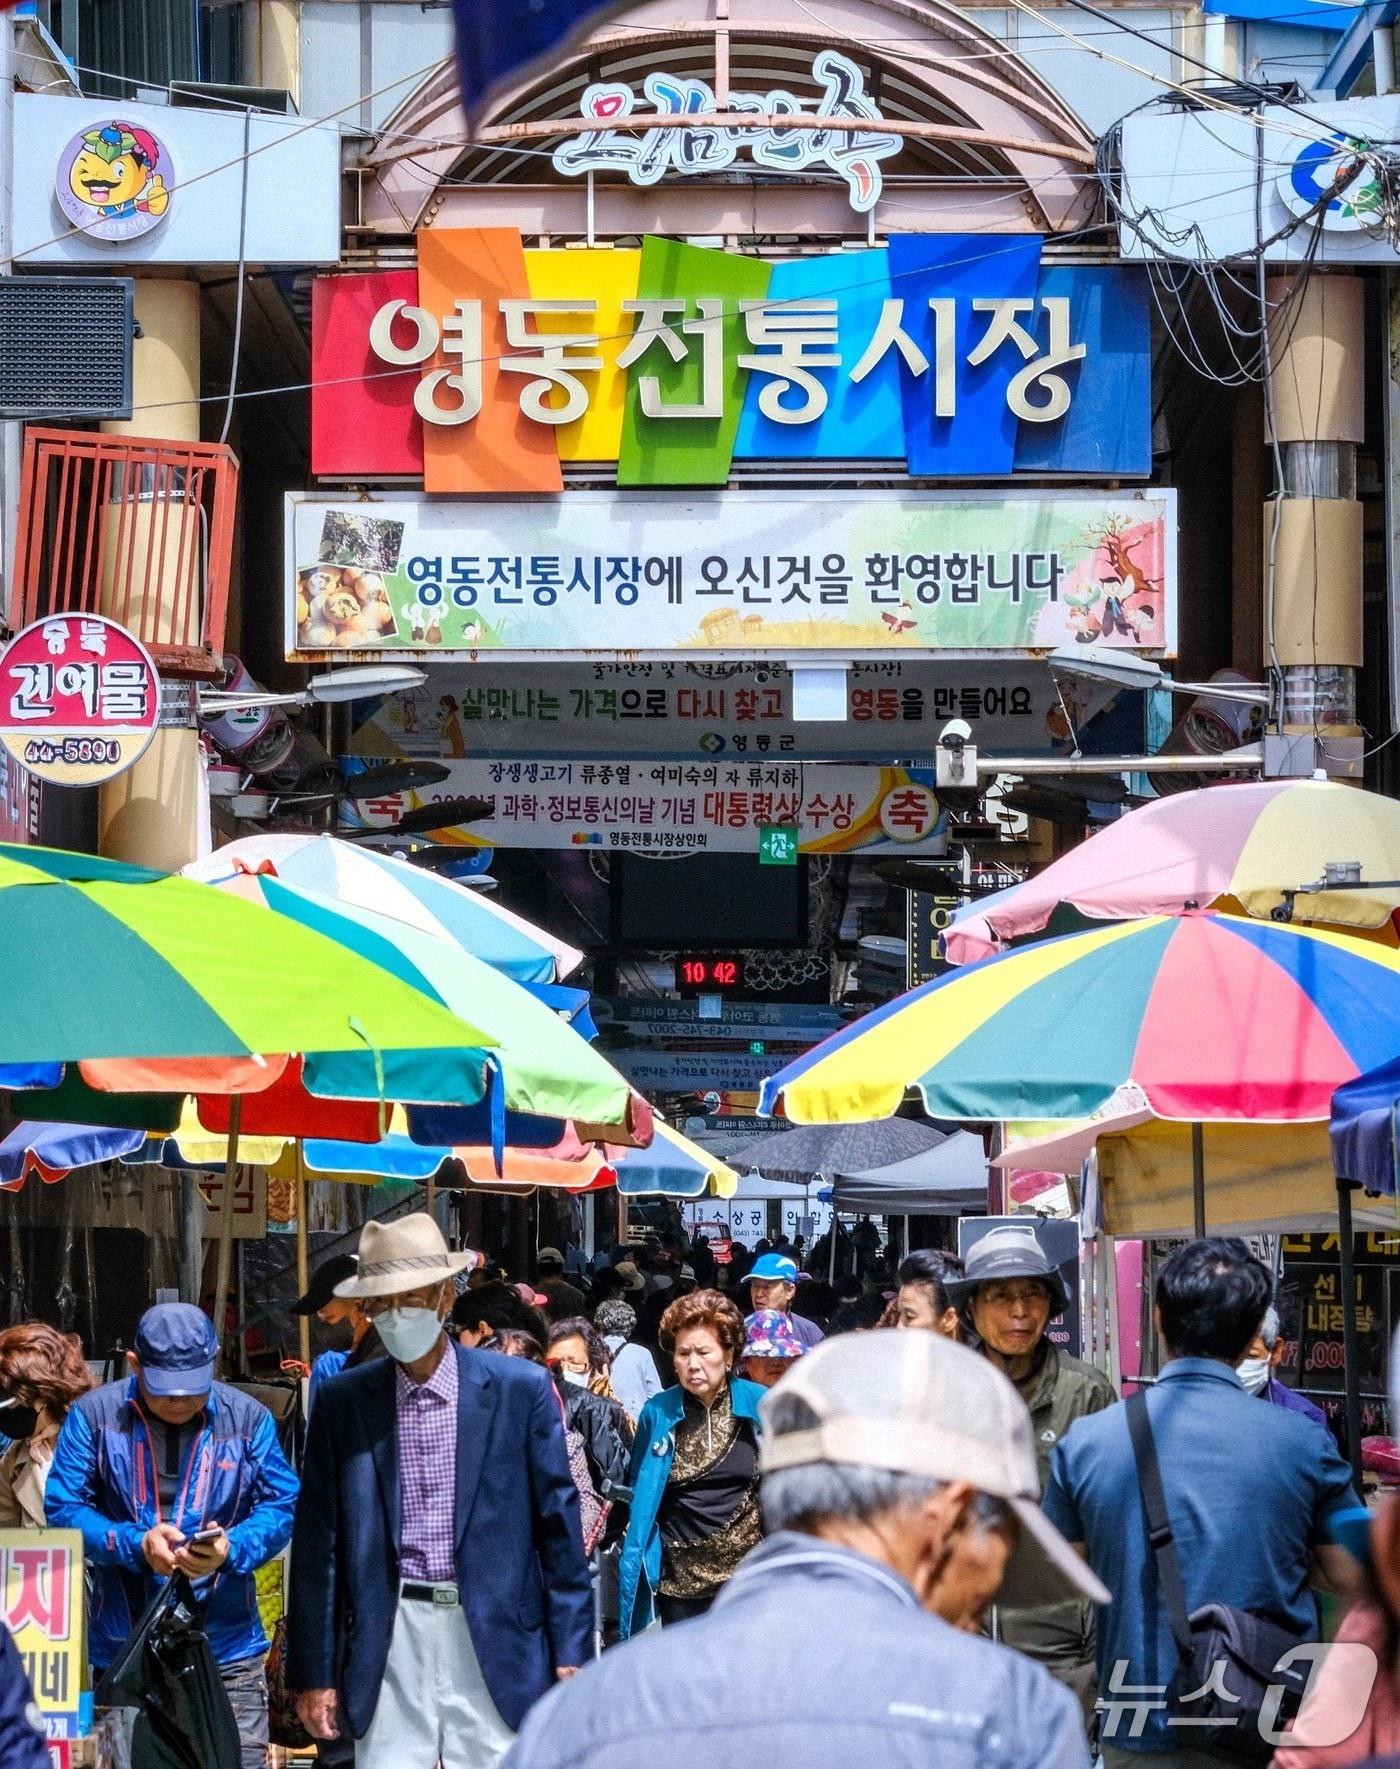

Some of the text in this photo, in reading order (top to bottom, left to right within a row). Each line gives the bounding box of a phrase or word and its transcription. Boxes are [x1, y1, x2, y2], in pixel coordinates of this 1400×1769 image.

[369, 298, 1087, 425] 영동전통시장
[407, 552, 1064, 606] 영동전통시장에 오신것을 환영합니다
[8, 661, 149, 720] 건어물
[461, 685, 1034, 722] 살맛나는 가격으로 다시 찾고 영동을 만들어요
[488, 762, 800, 789] 장생생고기 류종열 여미숙의 자 류지하
[660, 796, 696, 826] 기념
[702, 790, 801, 829] 대통령상
[805, 793, 856, 830] 수상
[888, 789, 930, 834] 축
[609, 831, 707, 848] 영동전통시장상인회
[683, 962, 736, 983] 10 42
[1, 1548, 68, 1638] 지
